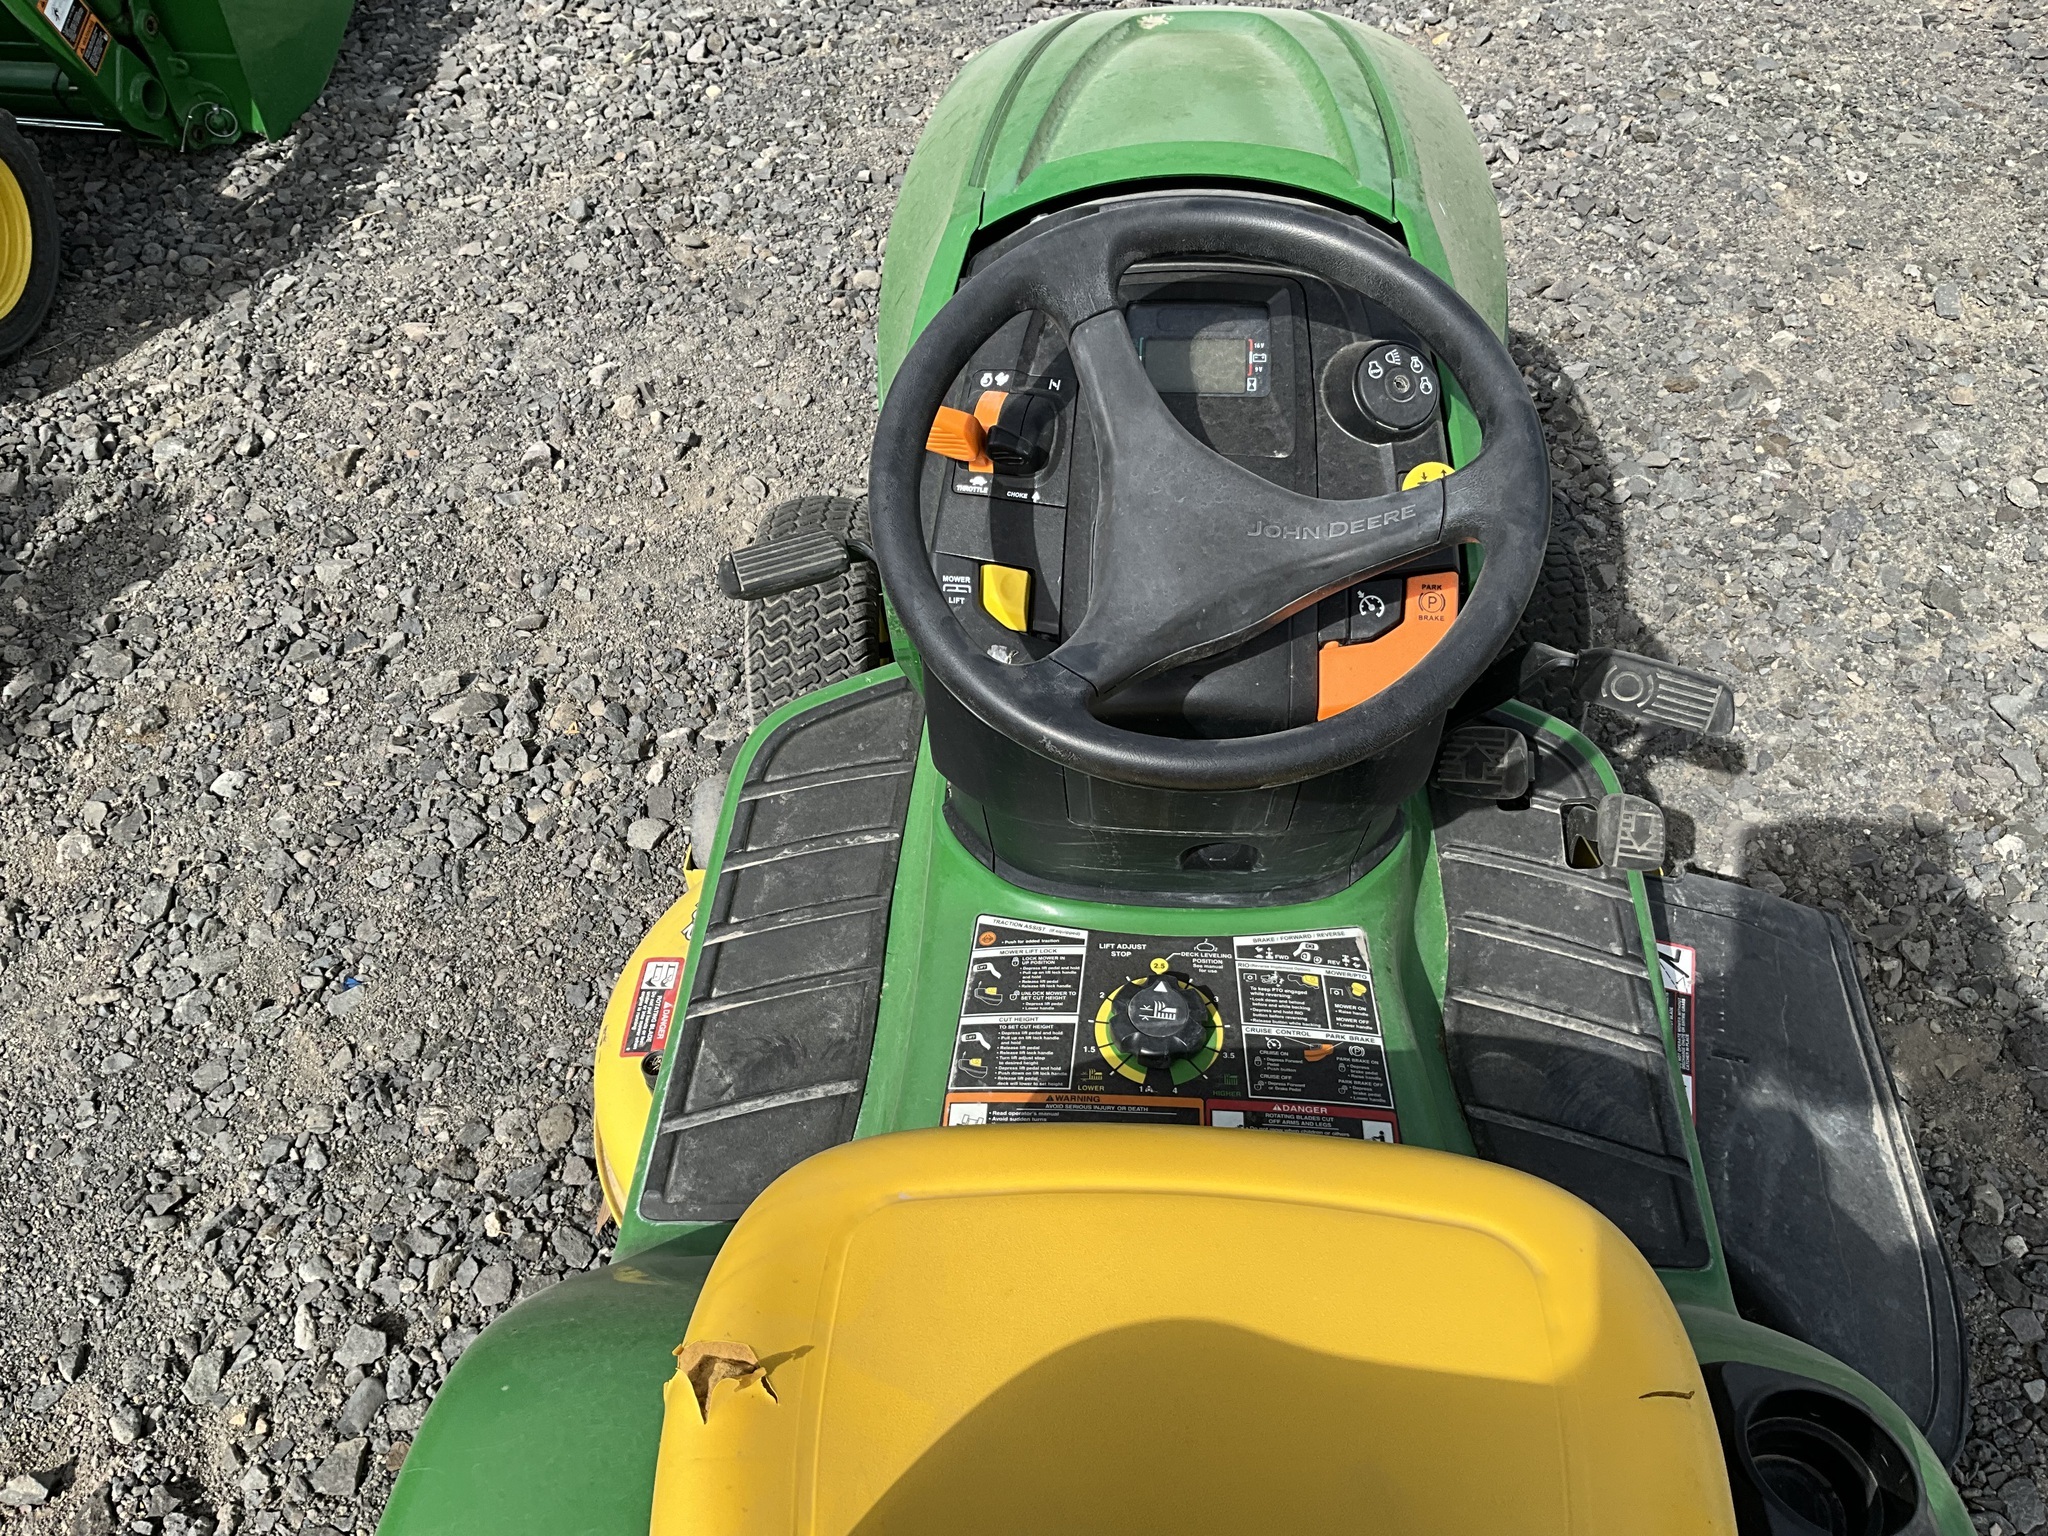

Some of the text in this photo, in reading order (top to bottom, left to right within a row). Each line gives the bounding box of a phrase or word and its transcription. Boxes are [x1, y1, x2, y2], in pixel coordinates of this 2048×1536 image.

[957, 485, 988, 494] THROTTLE
[1248, 504, 1416, 539] JOHN DEERE
[993, 919, 1022, 928] TRACTION
[1326, 970, 1367, 979] MOWER/PTO
[646, 996, 662, 1042] ROTATING BLADE
[657, 1010, 670, 1039] DANGER
[1283, 1104, 1327, 1114] DANGER
